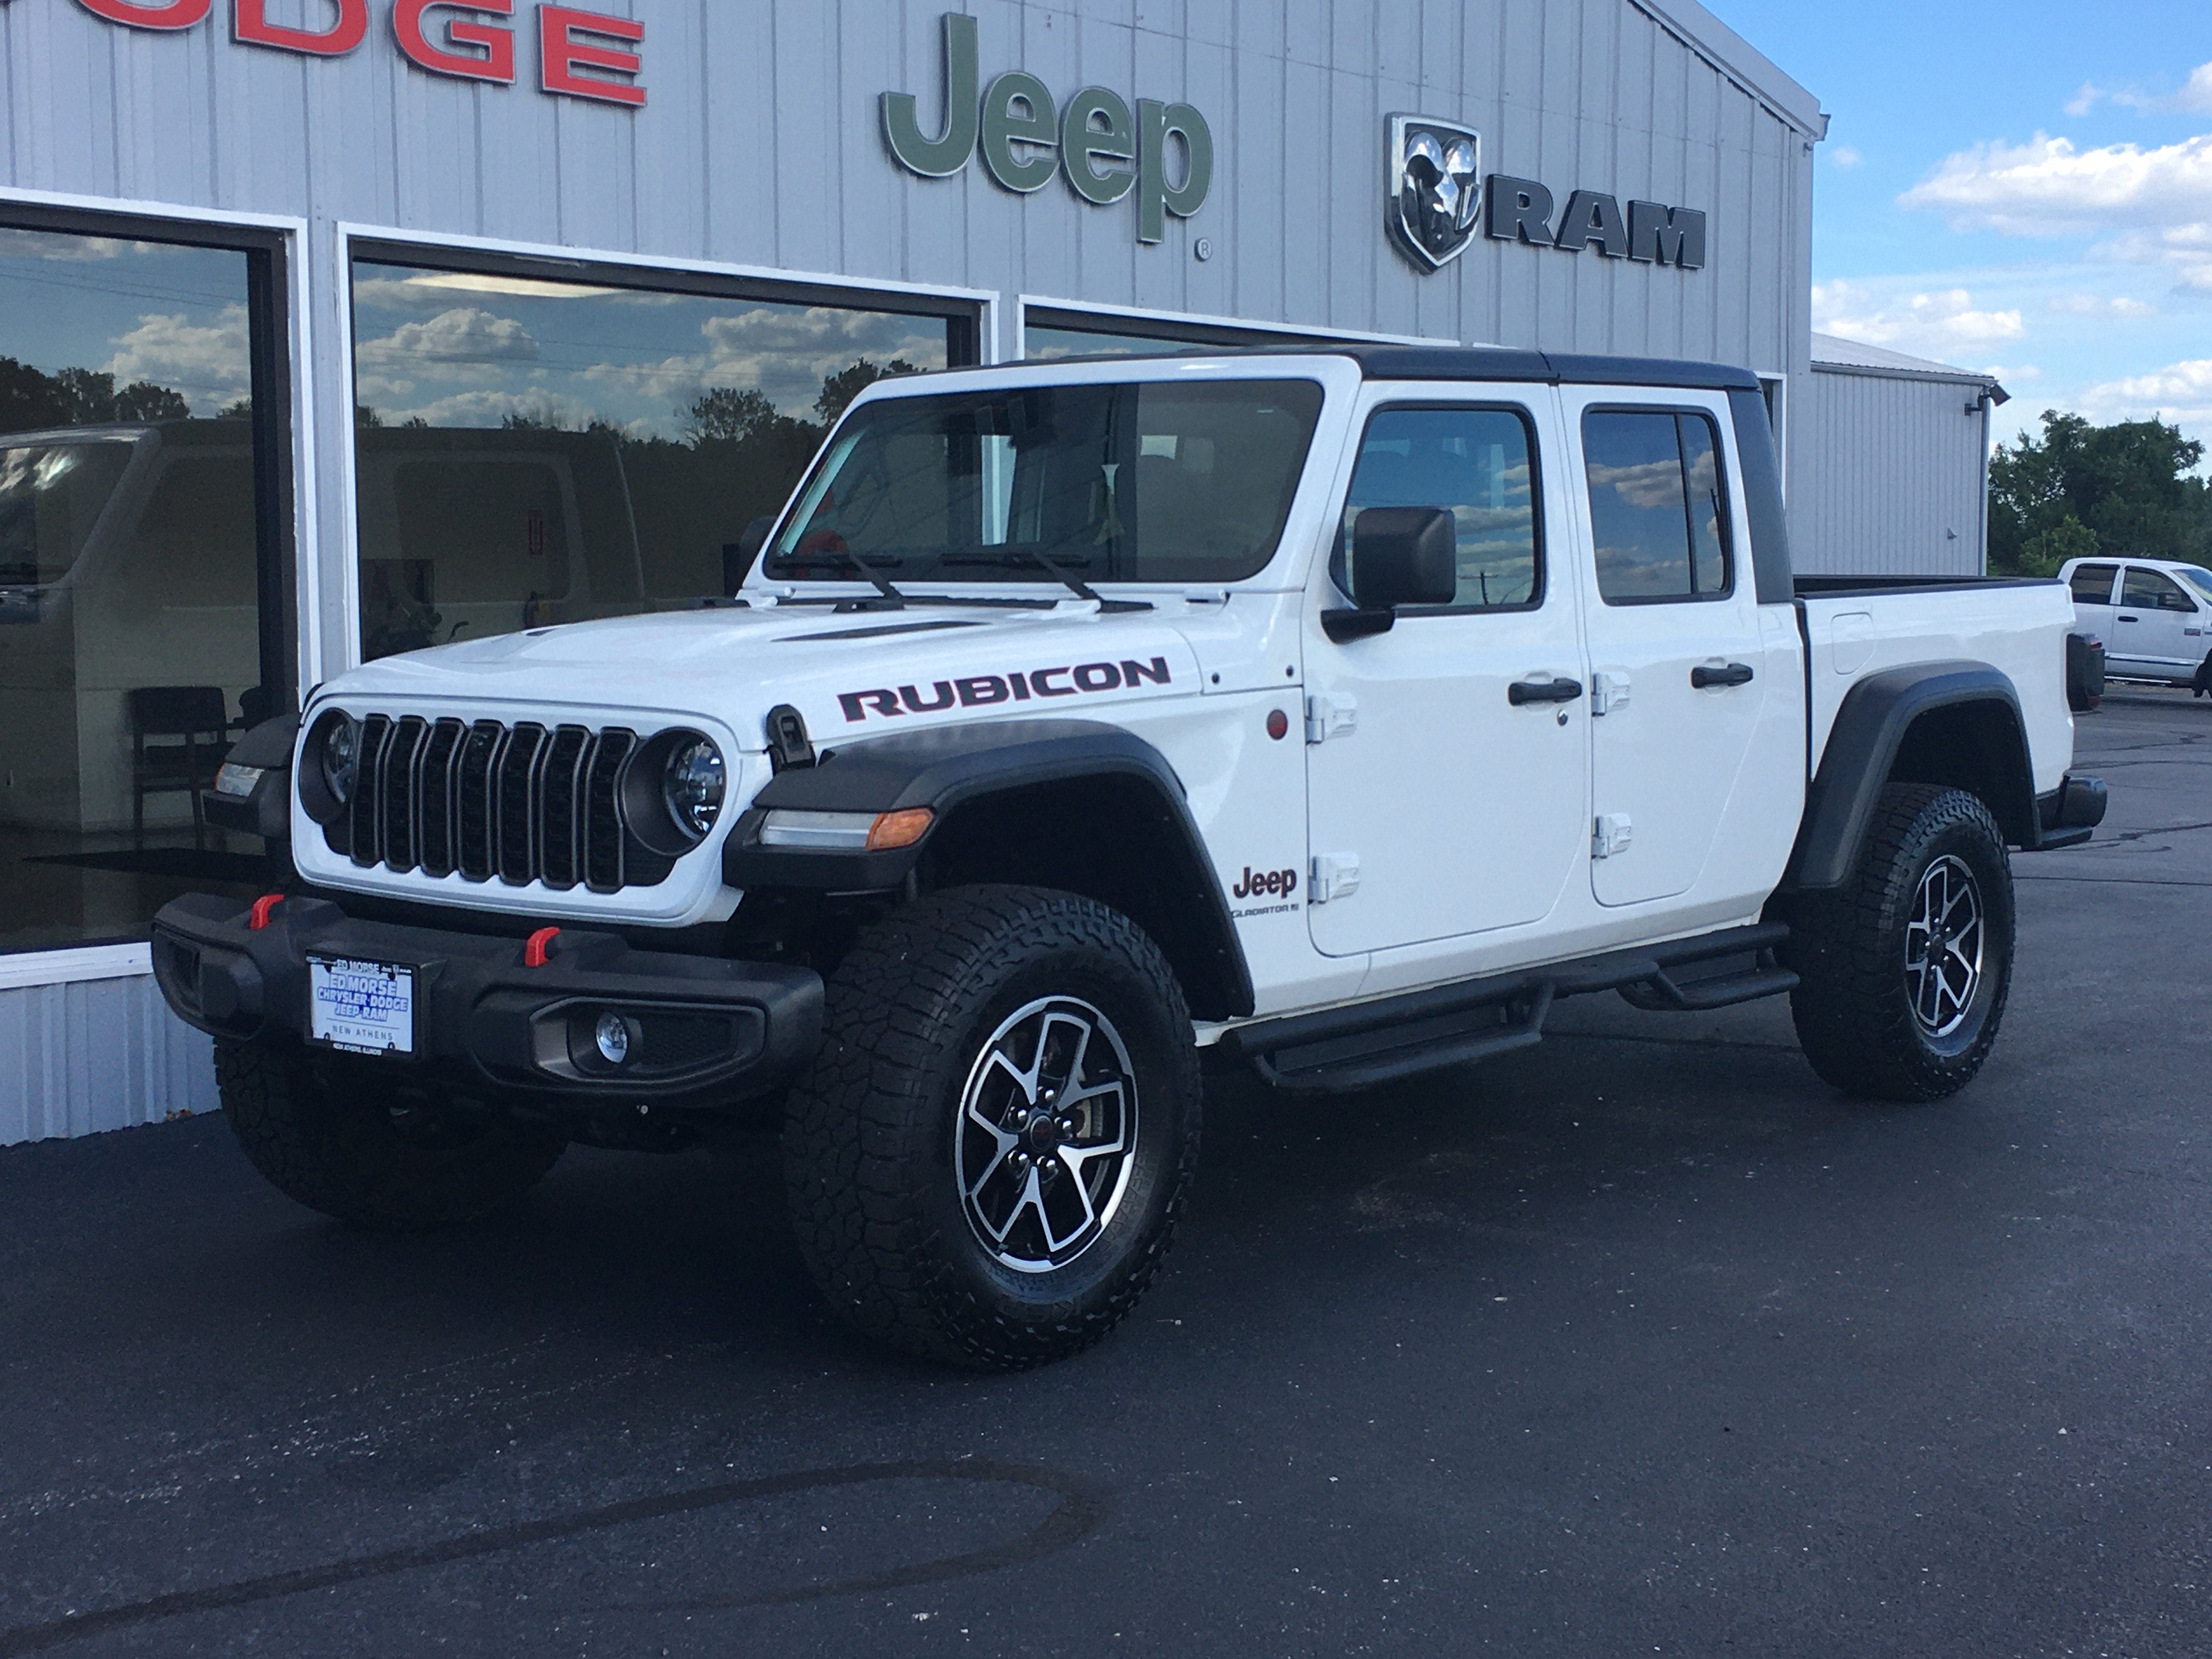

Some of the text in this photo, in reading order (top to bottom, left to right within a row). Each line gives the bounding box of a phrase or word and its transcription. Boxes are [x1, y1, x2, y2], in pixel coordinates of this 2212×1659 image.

[71, 0, 647, 107] DGE
[879, 12, 1214, 243] Jeep
[1486, 173, 1706, 269] RAM
[837, 656, 1171, 723] RUBICON
[1233, 867, 1297, 899] Jeep
[330, 974, 397, 996] ED MORSE
[332, 1025, 393, 1040] NEW ATHENS
